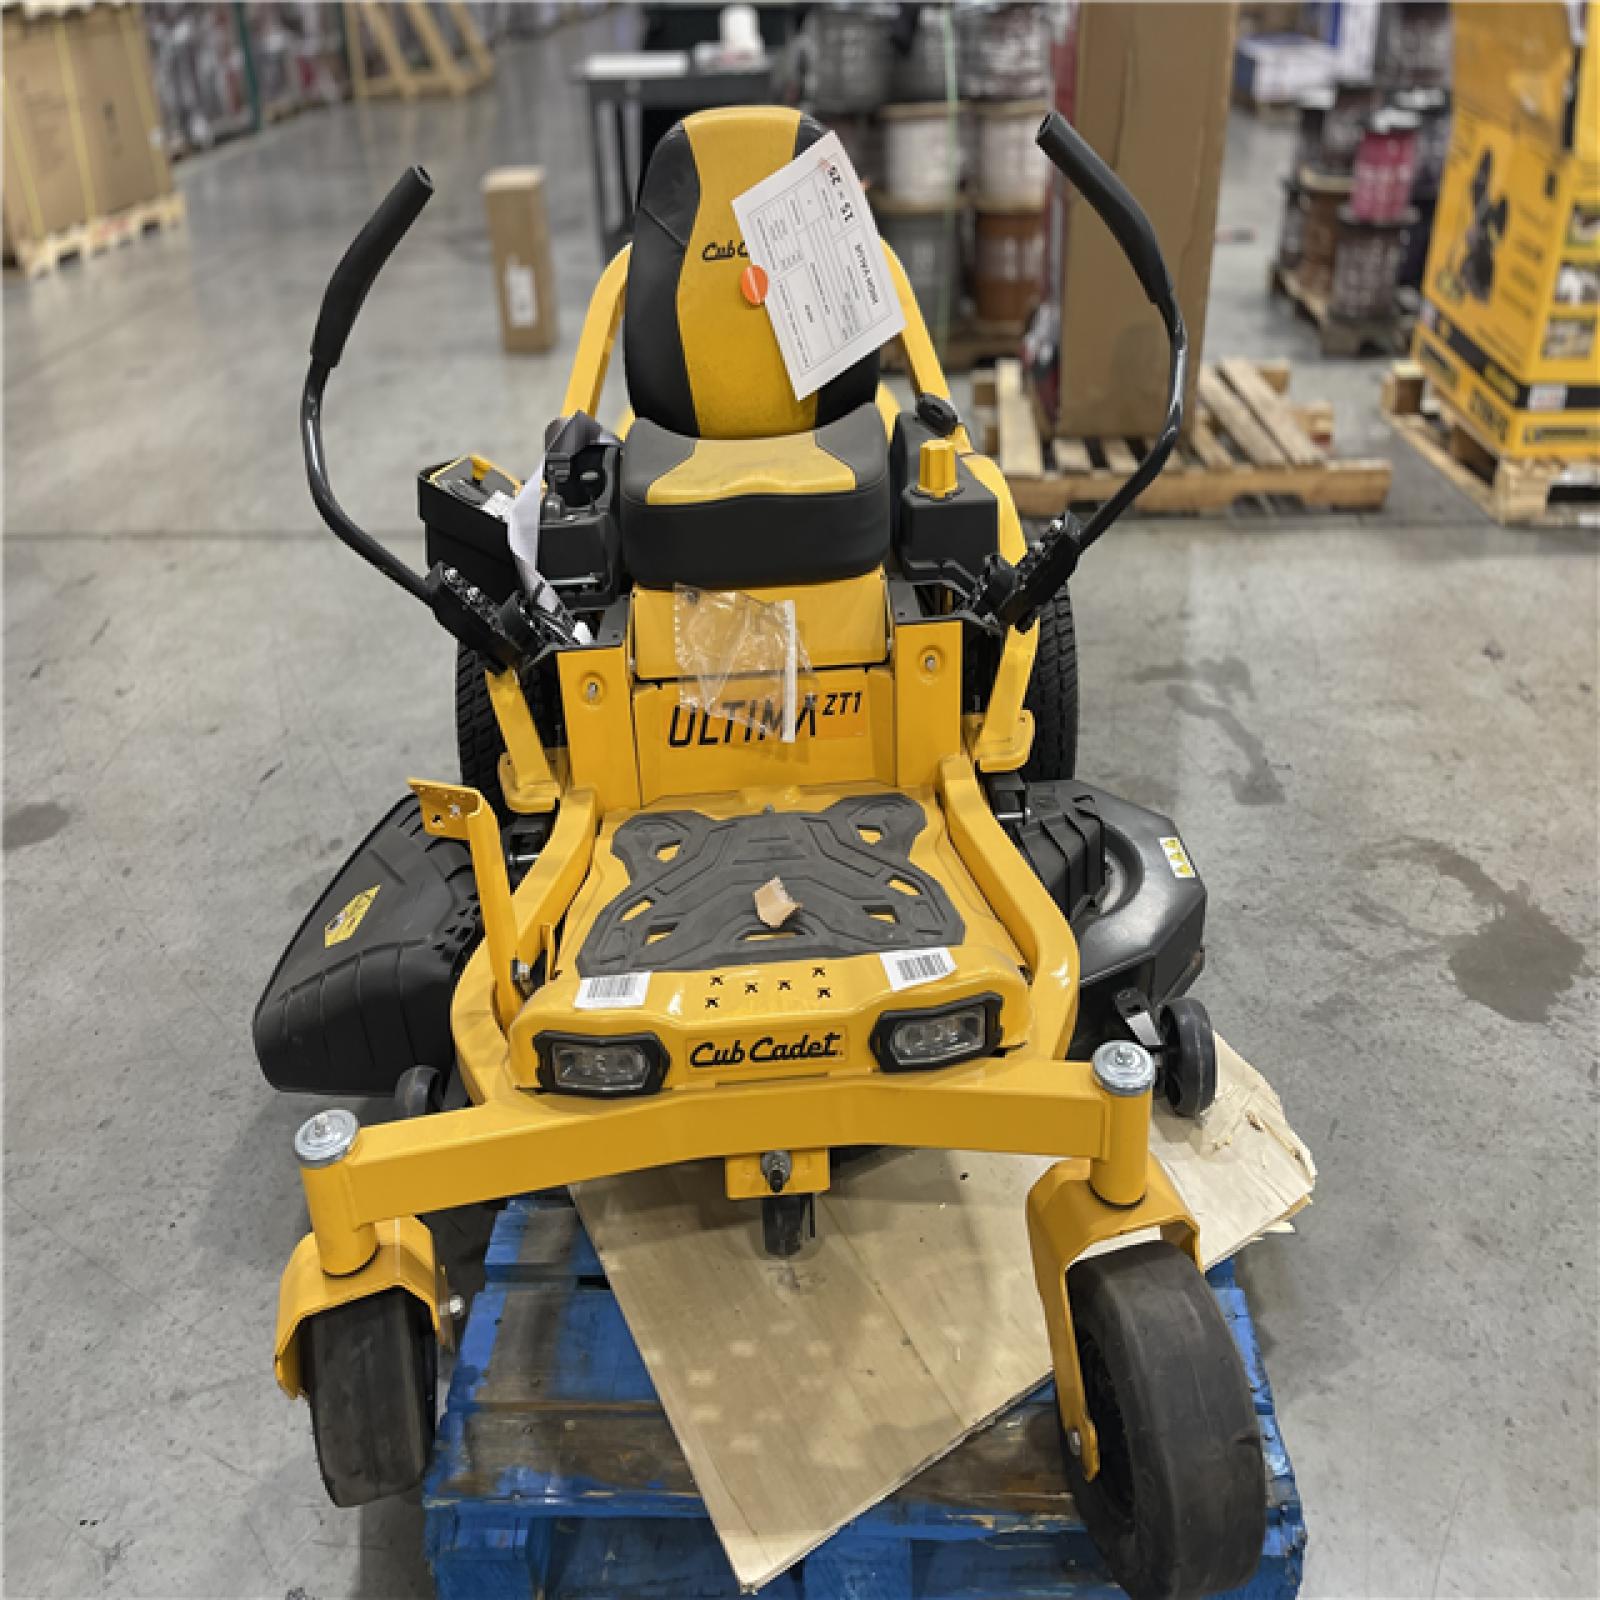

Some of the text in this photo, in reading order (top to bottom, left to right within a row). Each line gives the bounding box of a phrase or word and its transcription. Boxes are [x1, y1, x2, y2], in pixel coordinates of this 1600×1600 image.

[702, 240, 736, 262] Cub
[669, 690, 863, 747] ULTIMA ZT1
[689, 1032, 841, 1067] Cub Cadet
